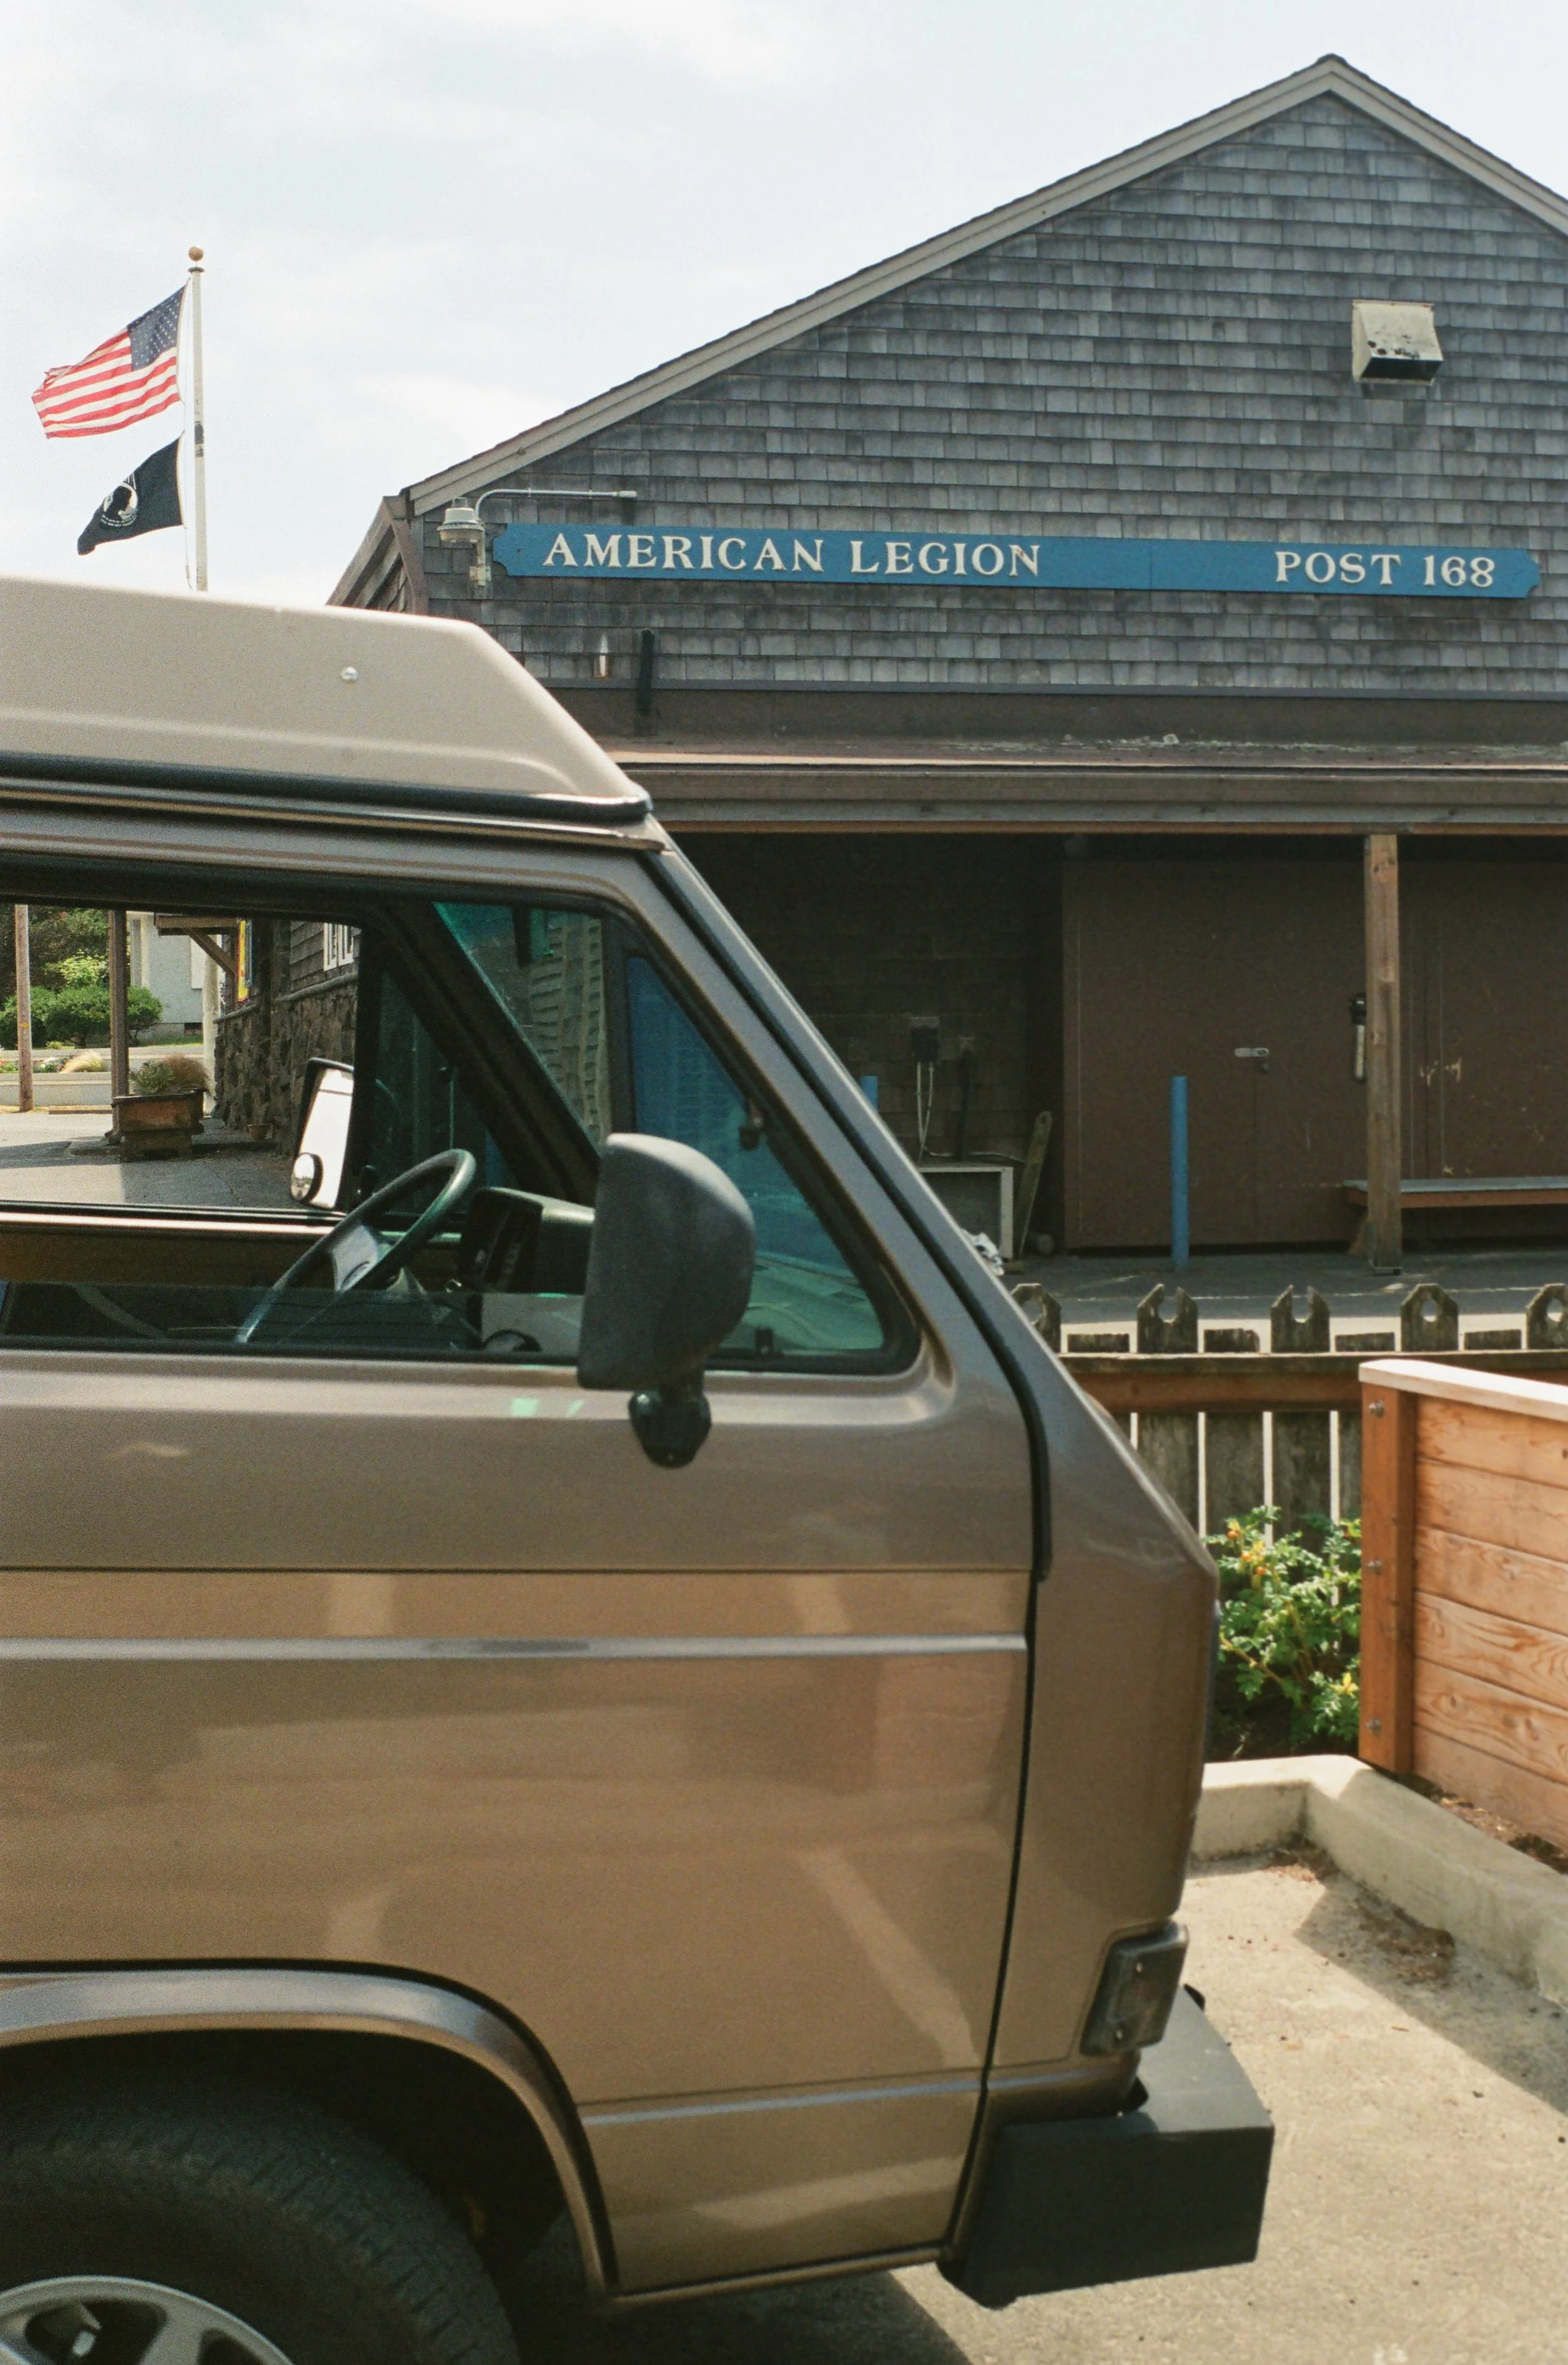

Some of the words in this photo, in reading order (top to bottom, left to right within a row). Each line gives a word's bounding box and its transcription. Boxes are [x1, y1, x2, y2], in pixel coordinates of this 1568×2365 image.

[543, 533, 824, 571] AMERICAN
[850, 540, 1041, 576] LEGION
[1275, 551, 1401, 585] POST
[1424, 555, 1496, 587] 168
